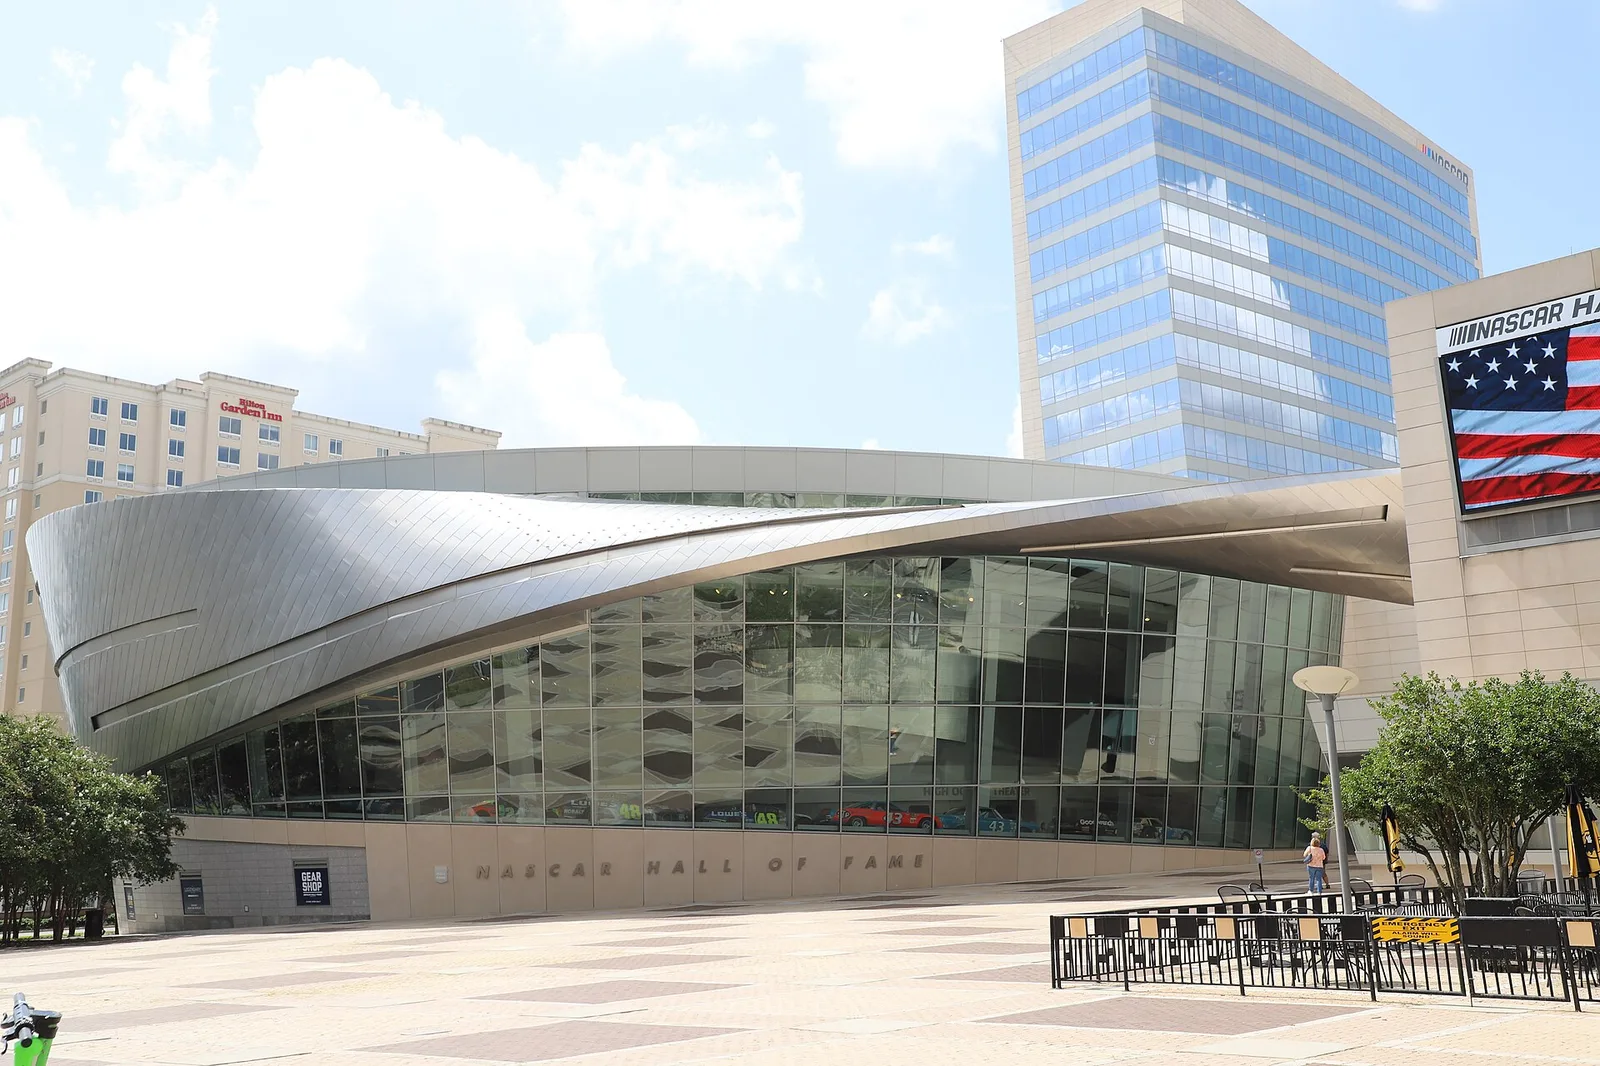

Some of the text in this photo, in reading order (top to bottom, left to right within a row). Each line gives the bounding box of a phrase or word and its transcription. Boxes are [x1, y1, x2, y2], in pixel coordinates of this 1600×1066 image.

[1475, 294, 1600, 341] NASCAR H
[239, 398, 265, 410] Hilton
[220, 401, 283, 422] Garden Inn
[923, 787, 949, 796] HGH
[988, 820, 1005, 832] 43
[476, 854, 924, 880] NASCAR HALL OF FAME
[301, 871, 322, 882] GEAR
[302, 881, 323, 892] SHOP
